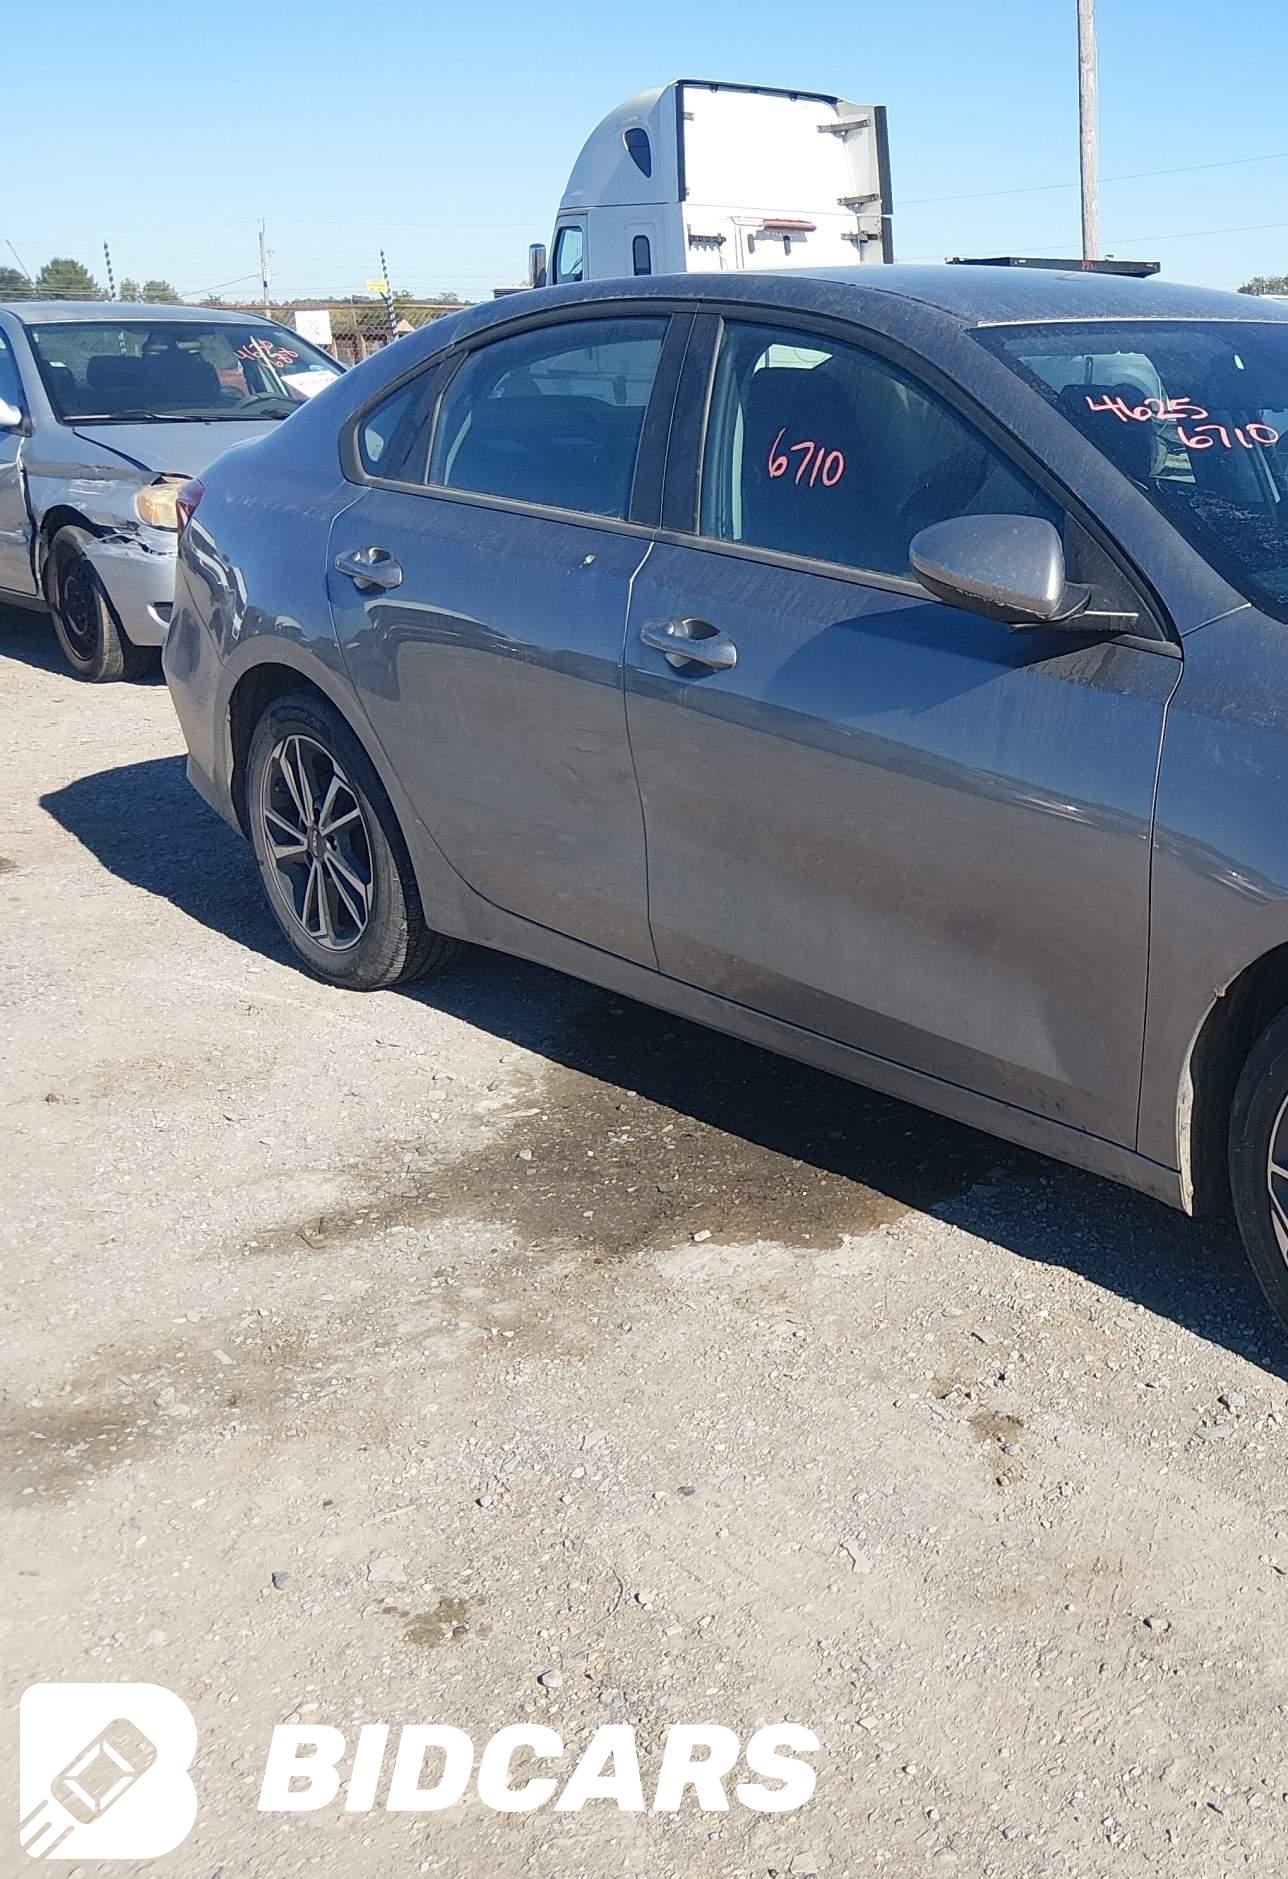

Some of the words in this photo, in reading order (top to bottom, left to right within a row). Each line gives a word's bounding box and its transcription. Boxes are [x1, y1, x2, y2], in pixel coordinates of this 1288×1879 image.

[1085, 395, 1208, 422] 4625
[1177, 423, 1279, 449] 6710
[768, 427, 845, 488] 6710
